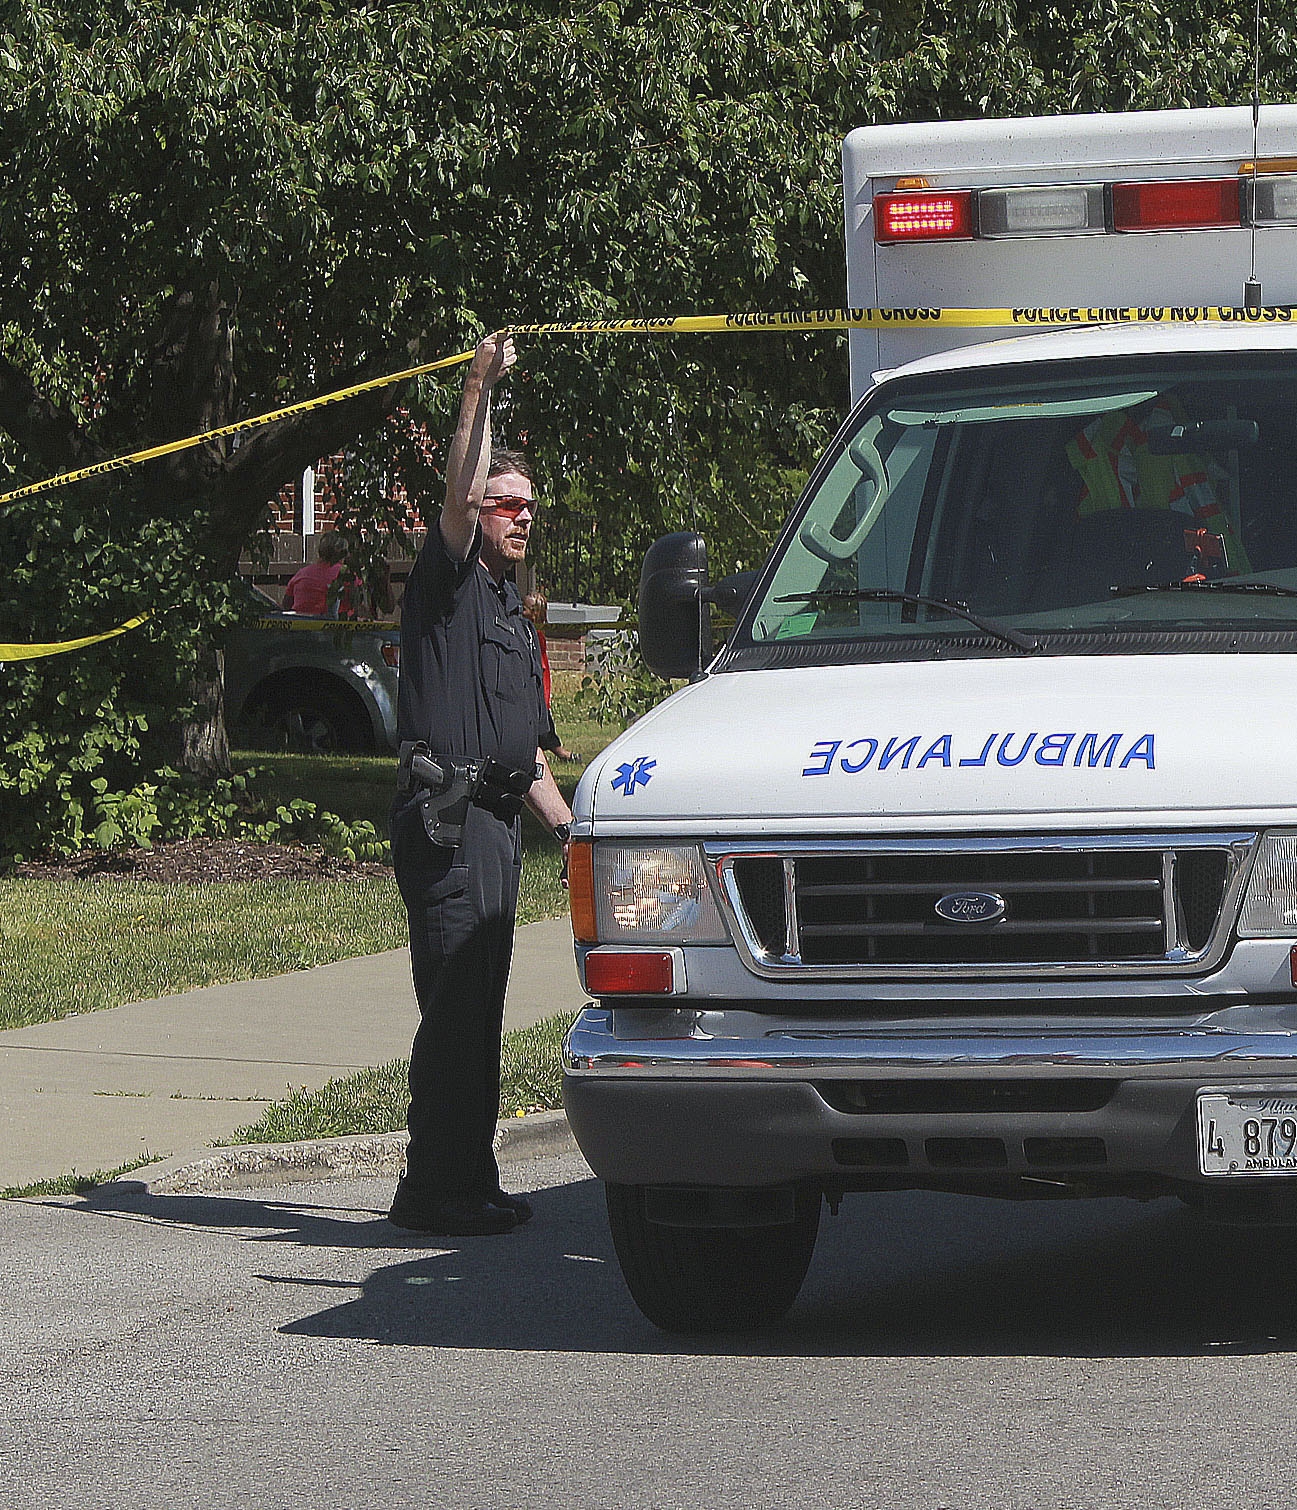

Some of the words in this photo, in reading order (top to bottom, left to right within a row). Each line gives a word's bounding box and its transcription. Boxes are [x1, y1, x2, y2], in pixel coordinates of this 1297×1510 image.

[726, 311, 777, 327] POLICE
[781, 309, 813, 325] LINE
[880, 308, 941, 320] CROSS
[1012, 307, 1078, 322] POLICE
[1087, 307, 1130, 322] LINE
[1138, 306, 1162, 321] DO
[1171, 306, 1208, 321] NOT
[1218, 306, 1291, 321] CROSS
[951, 897, 986, 914] Ford
[1207, 1119, 1225, 1157] 4
[1244, 1117, 1297, 1158] 879
